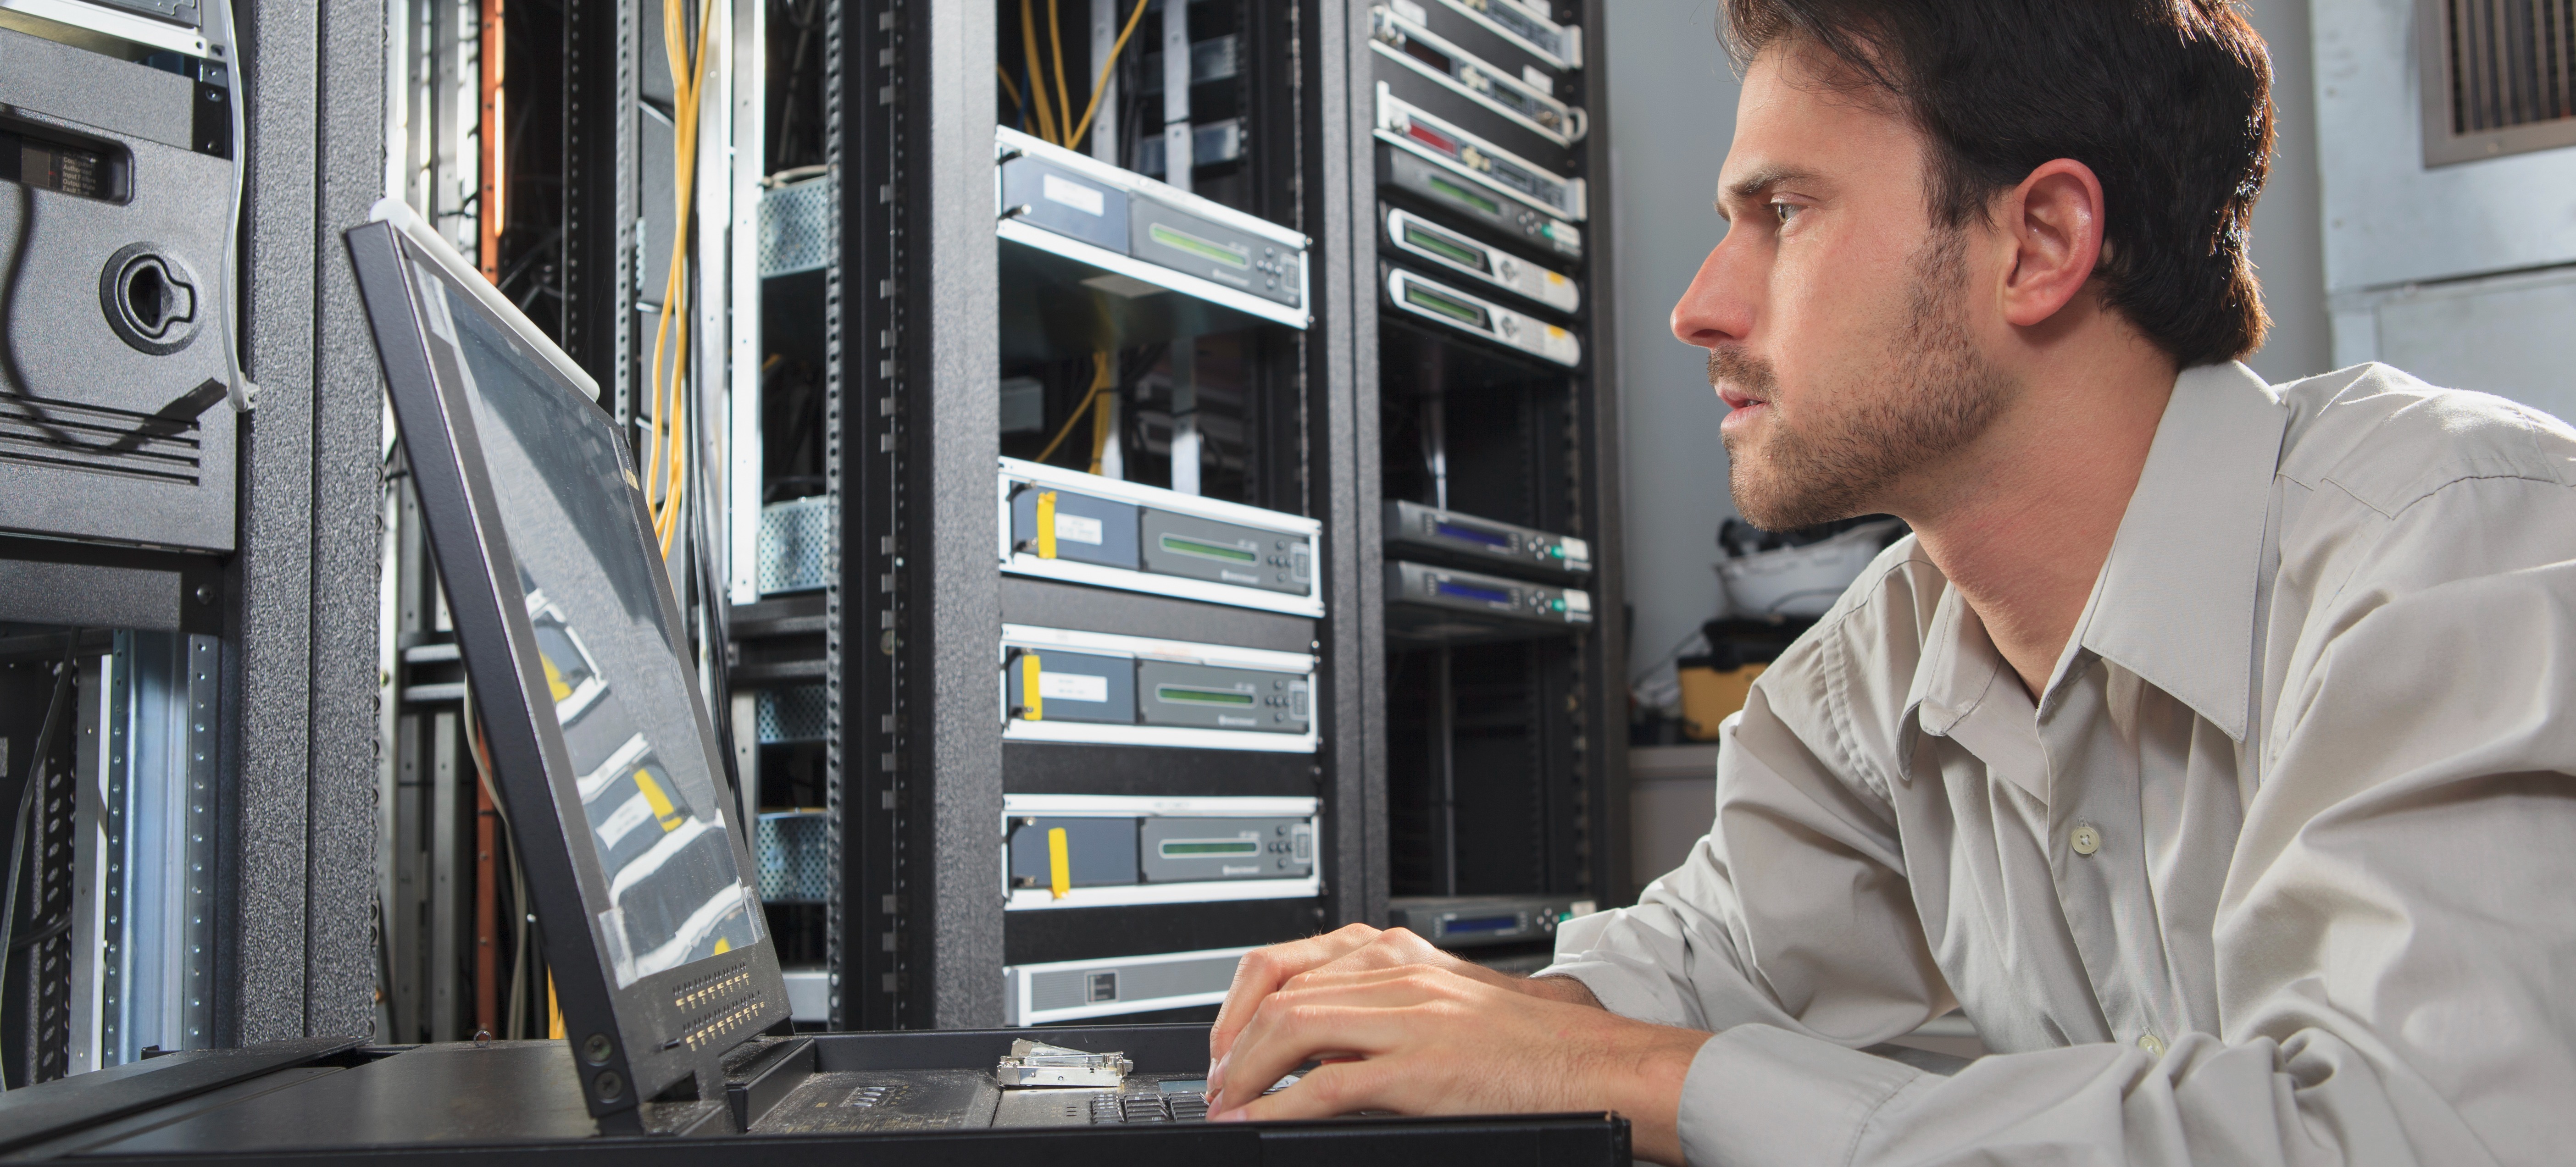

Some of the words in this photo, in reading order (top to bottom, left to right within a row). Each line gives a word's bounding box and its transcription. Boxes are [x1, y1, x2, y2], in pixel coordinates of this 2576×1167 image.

[63, 156, 93, 168] Configured
[63, 164, 92, 175] Authorized
[63, 171, 77, 180] Input
[78, 175, 96, 183] Failure
[63, 178, 81, 188] Output
[62, 185, 77, 194] Fault
